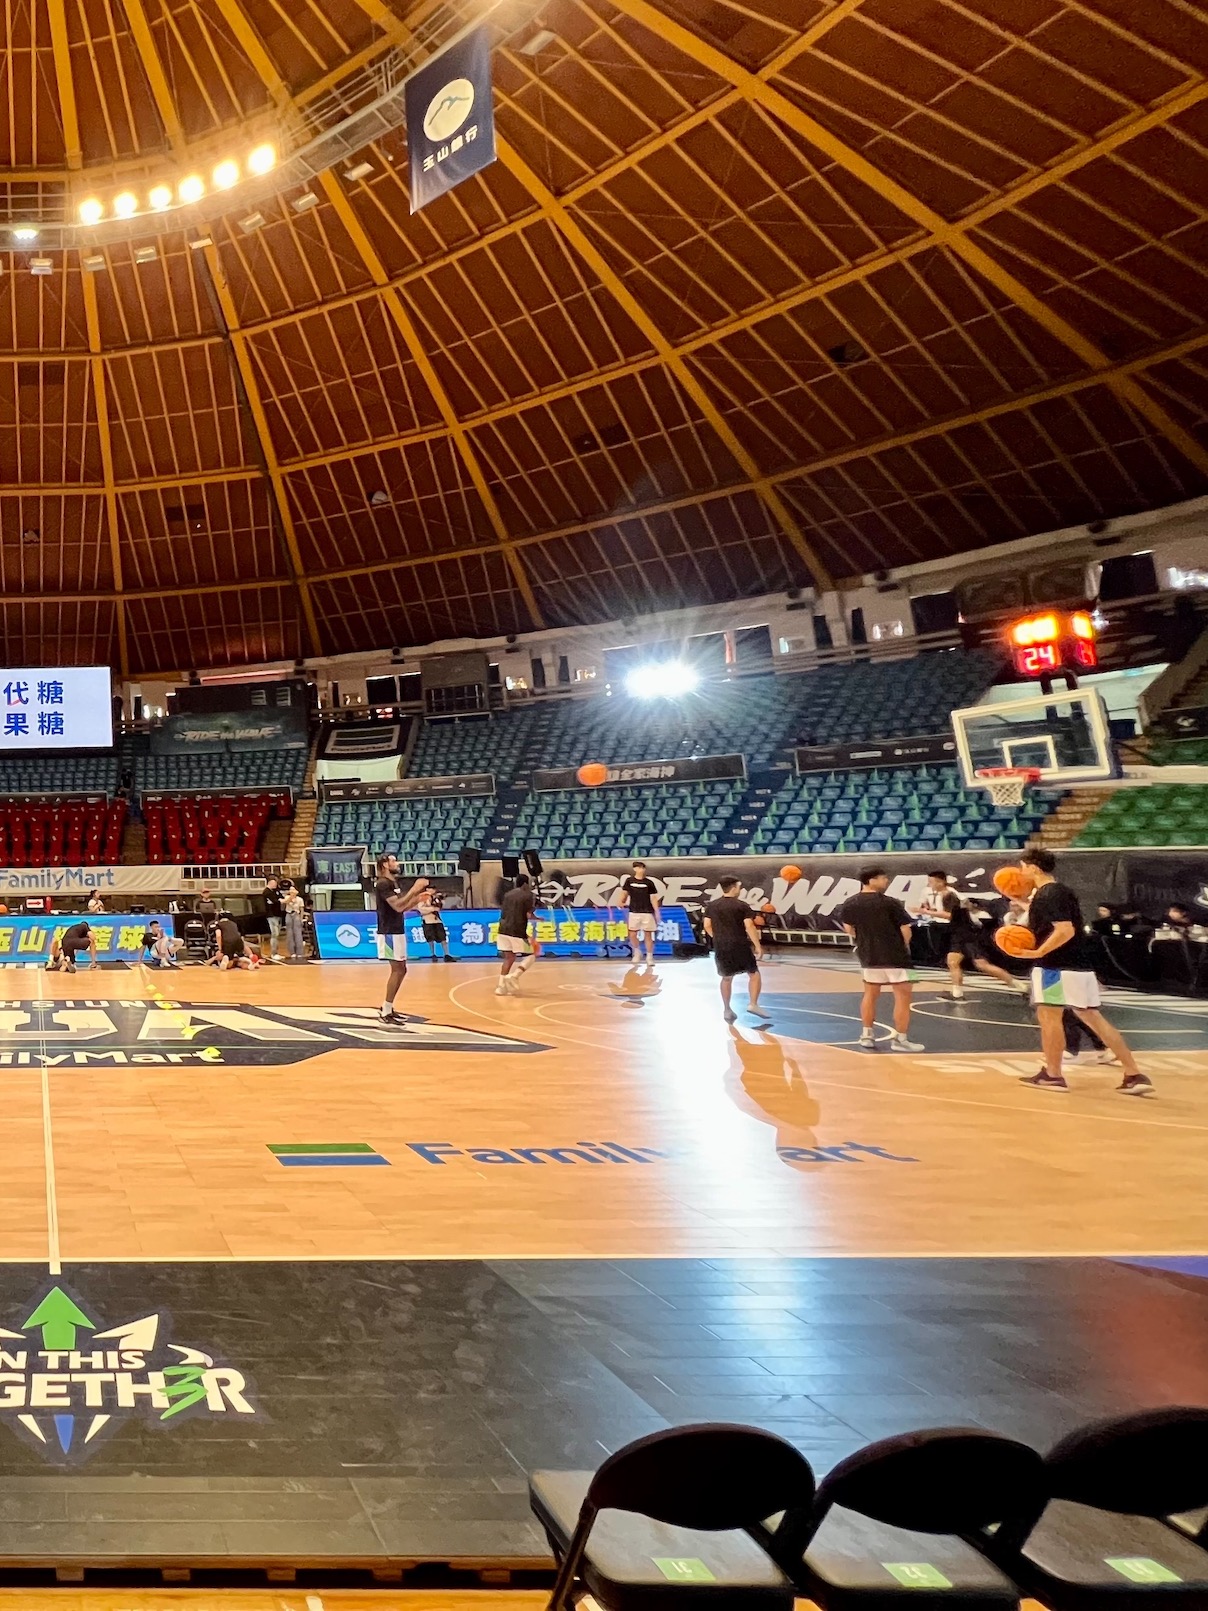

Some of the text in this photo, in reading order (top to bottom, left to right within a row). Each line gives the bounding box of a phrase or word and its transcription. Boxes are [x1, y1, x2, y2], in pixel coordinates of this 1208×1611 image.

[1024, 645, 1056, 671] 24
[333, 861, 356, 874] EAST
[38, 1350, 148, 1370] THIS
